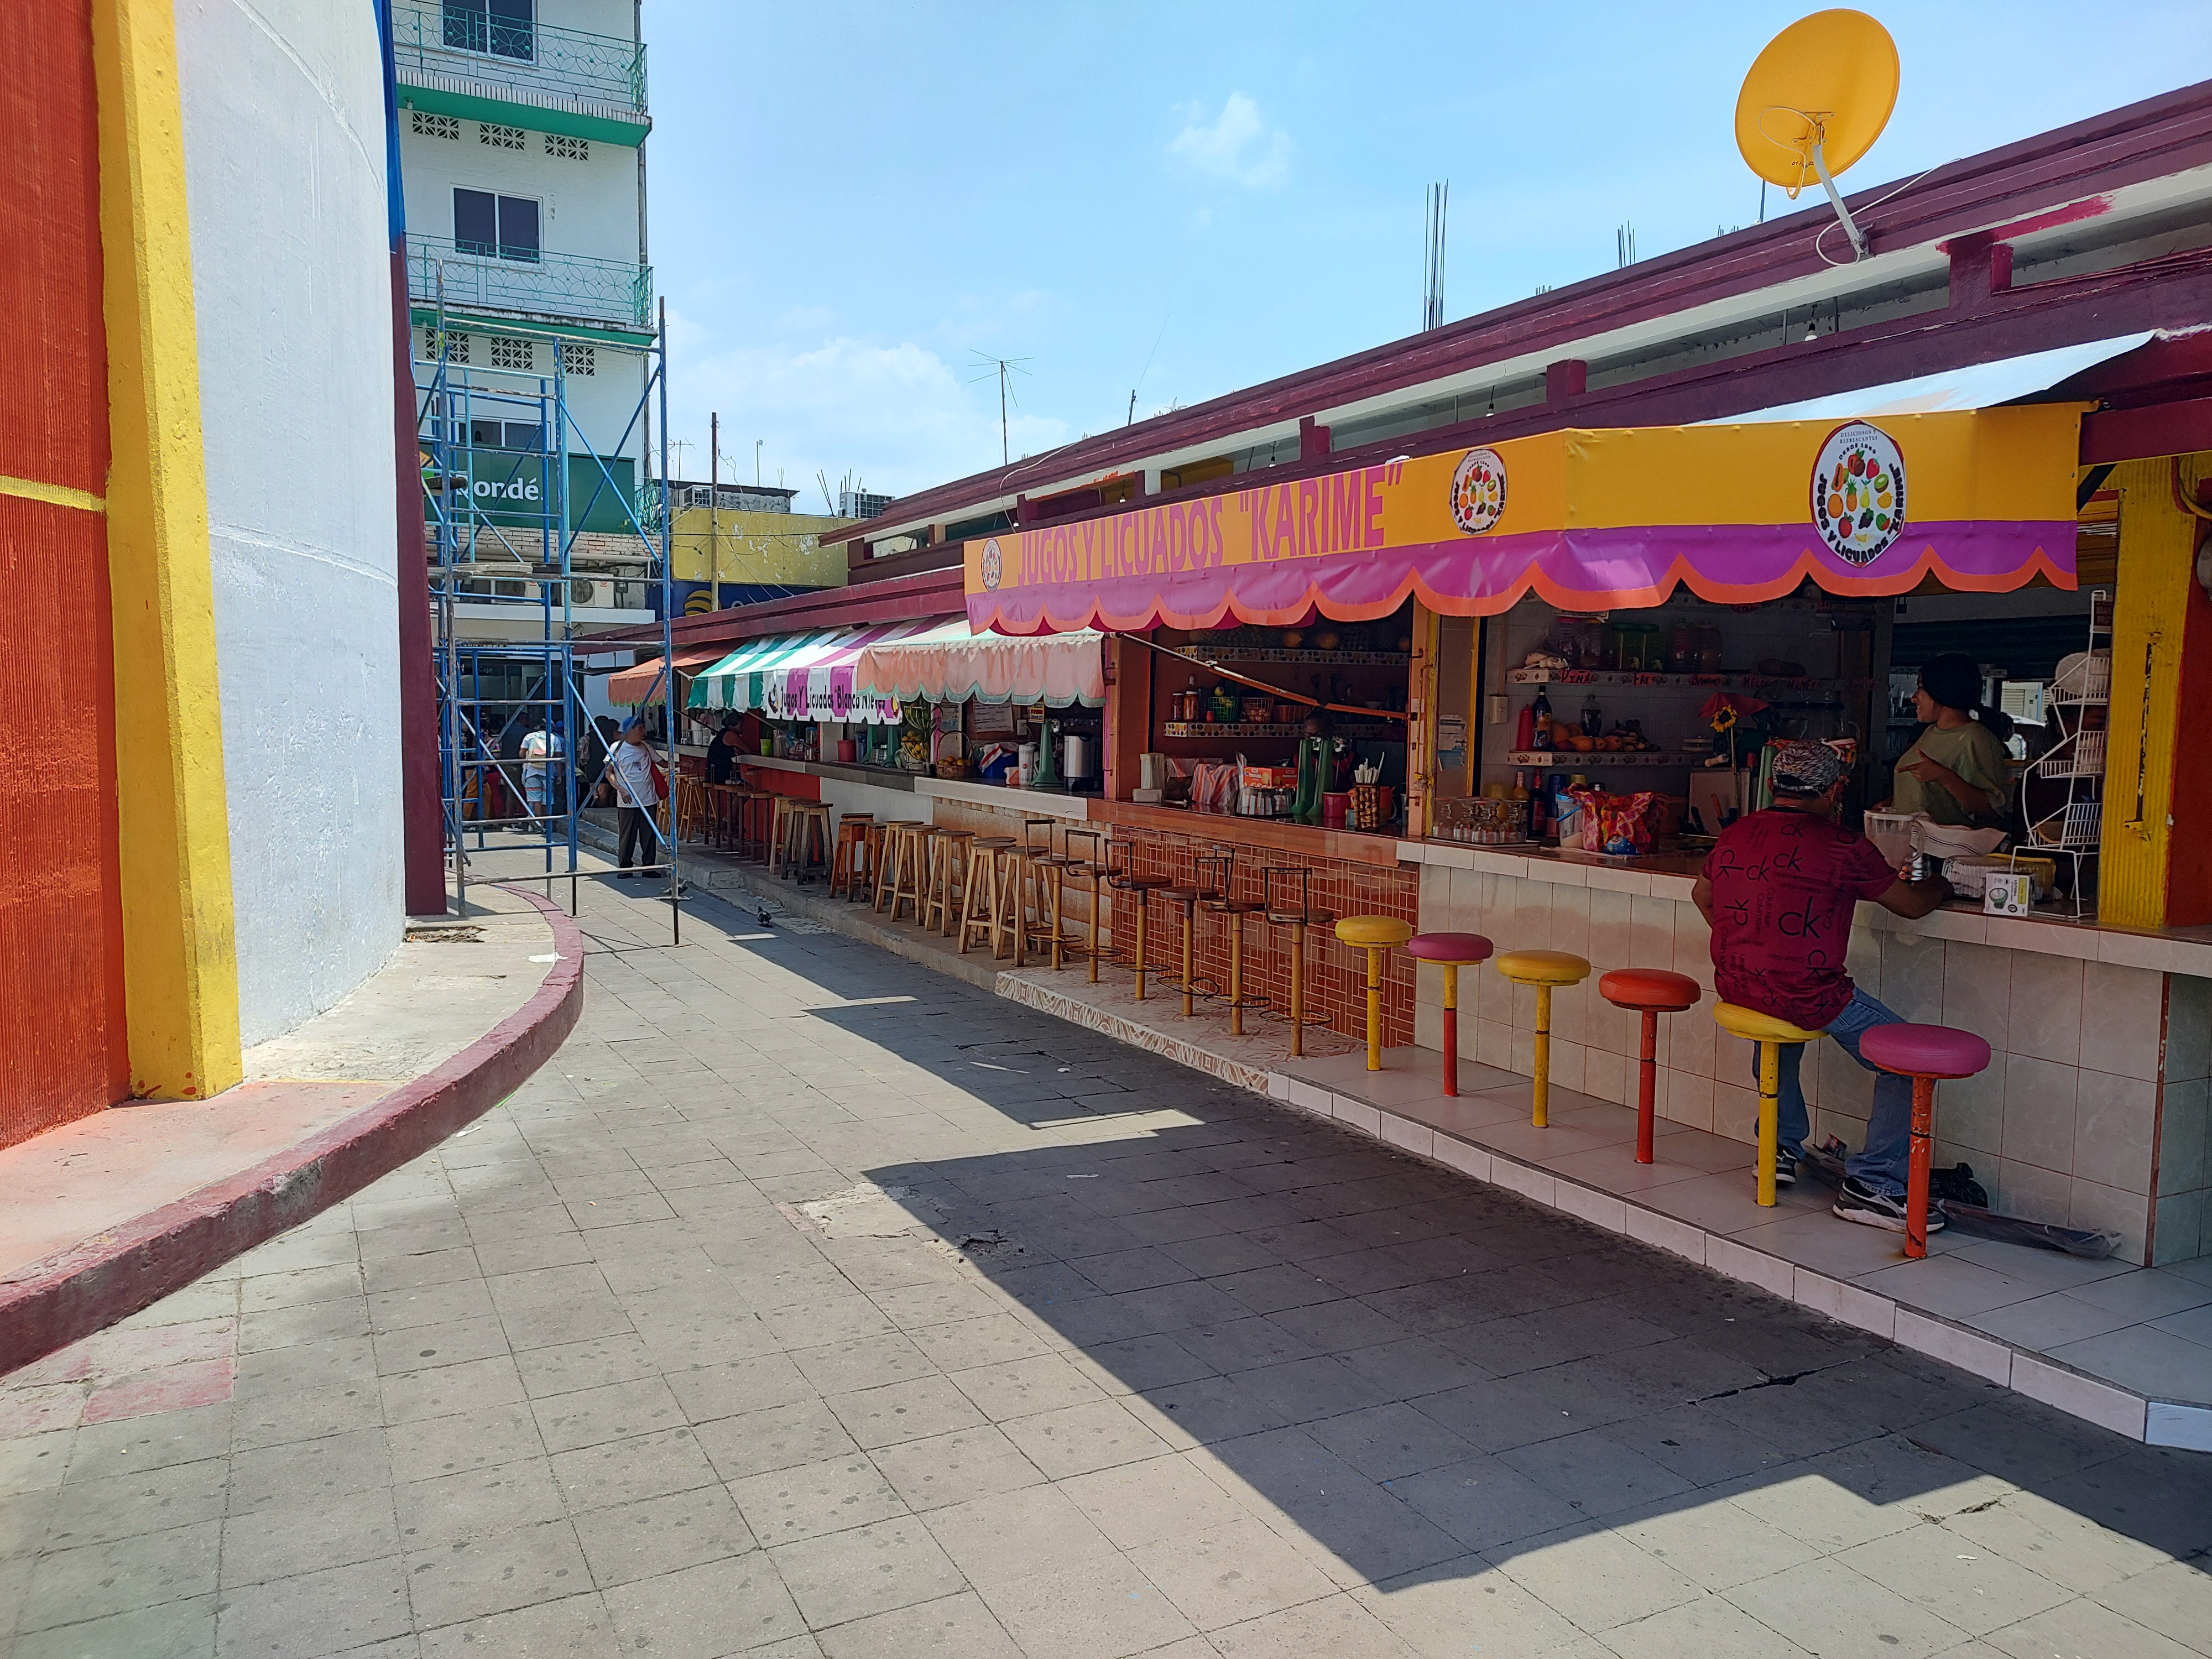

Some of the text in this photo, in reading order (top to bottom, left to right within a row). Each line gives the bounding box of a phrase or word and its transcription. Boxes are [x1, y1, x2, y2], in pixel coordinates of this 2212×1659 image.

[1839, 443, 1859, 460] DESDE
[1018, 523, 1078, 587] JUGOS
[1082, 521, 1095, 581] Y
[1100, 496, 1223, 578] LICUADOS
[1239, 462, 1402, 562] "KARIME"
[1817, 473, 1830, 530] JUGOS
[1827, 529, 1837, 542] Y
[1834, 536, 1888, 563] LICUADOS
[1561, 670, 1590, 684] PIÑA
[780, 685, 797, 713] Jugos
[799, 686, 804, 708] Y
[806, 685, 833, 709] Licuados
[1716, 849, 1744, 879] ck
[1746, 855, 1770, 882] ck
[1773, 845, 1804, 872] ck
[1725, 899, 1749, 926] ck
[1778, 896, 1821, 939] ck
